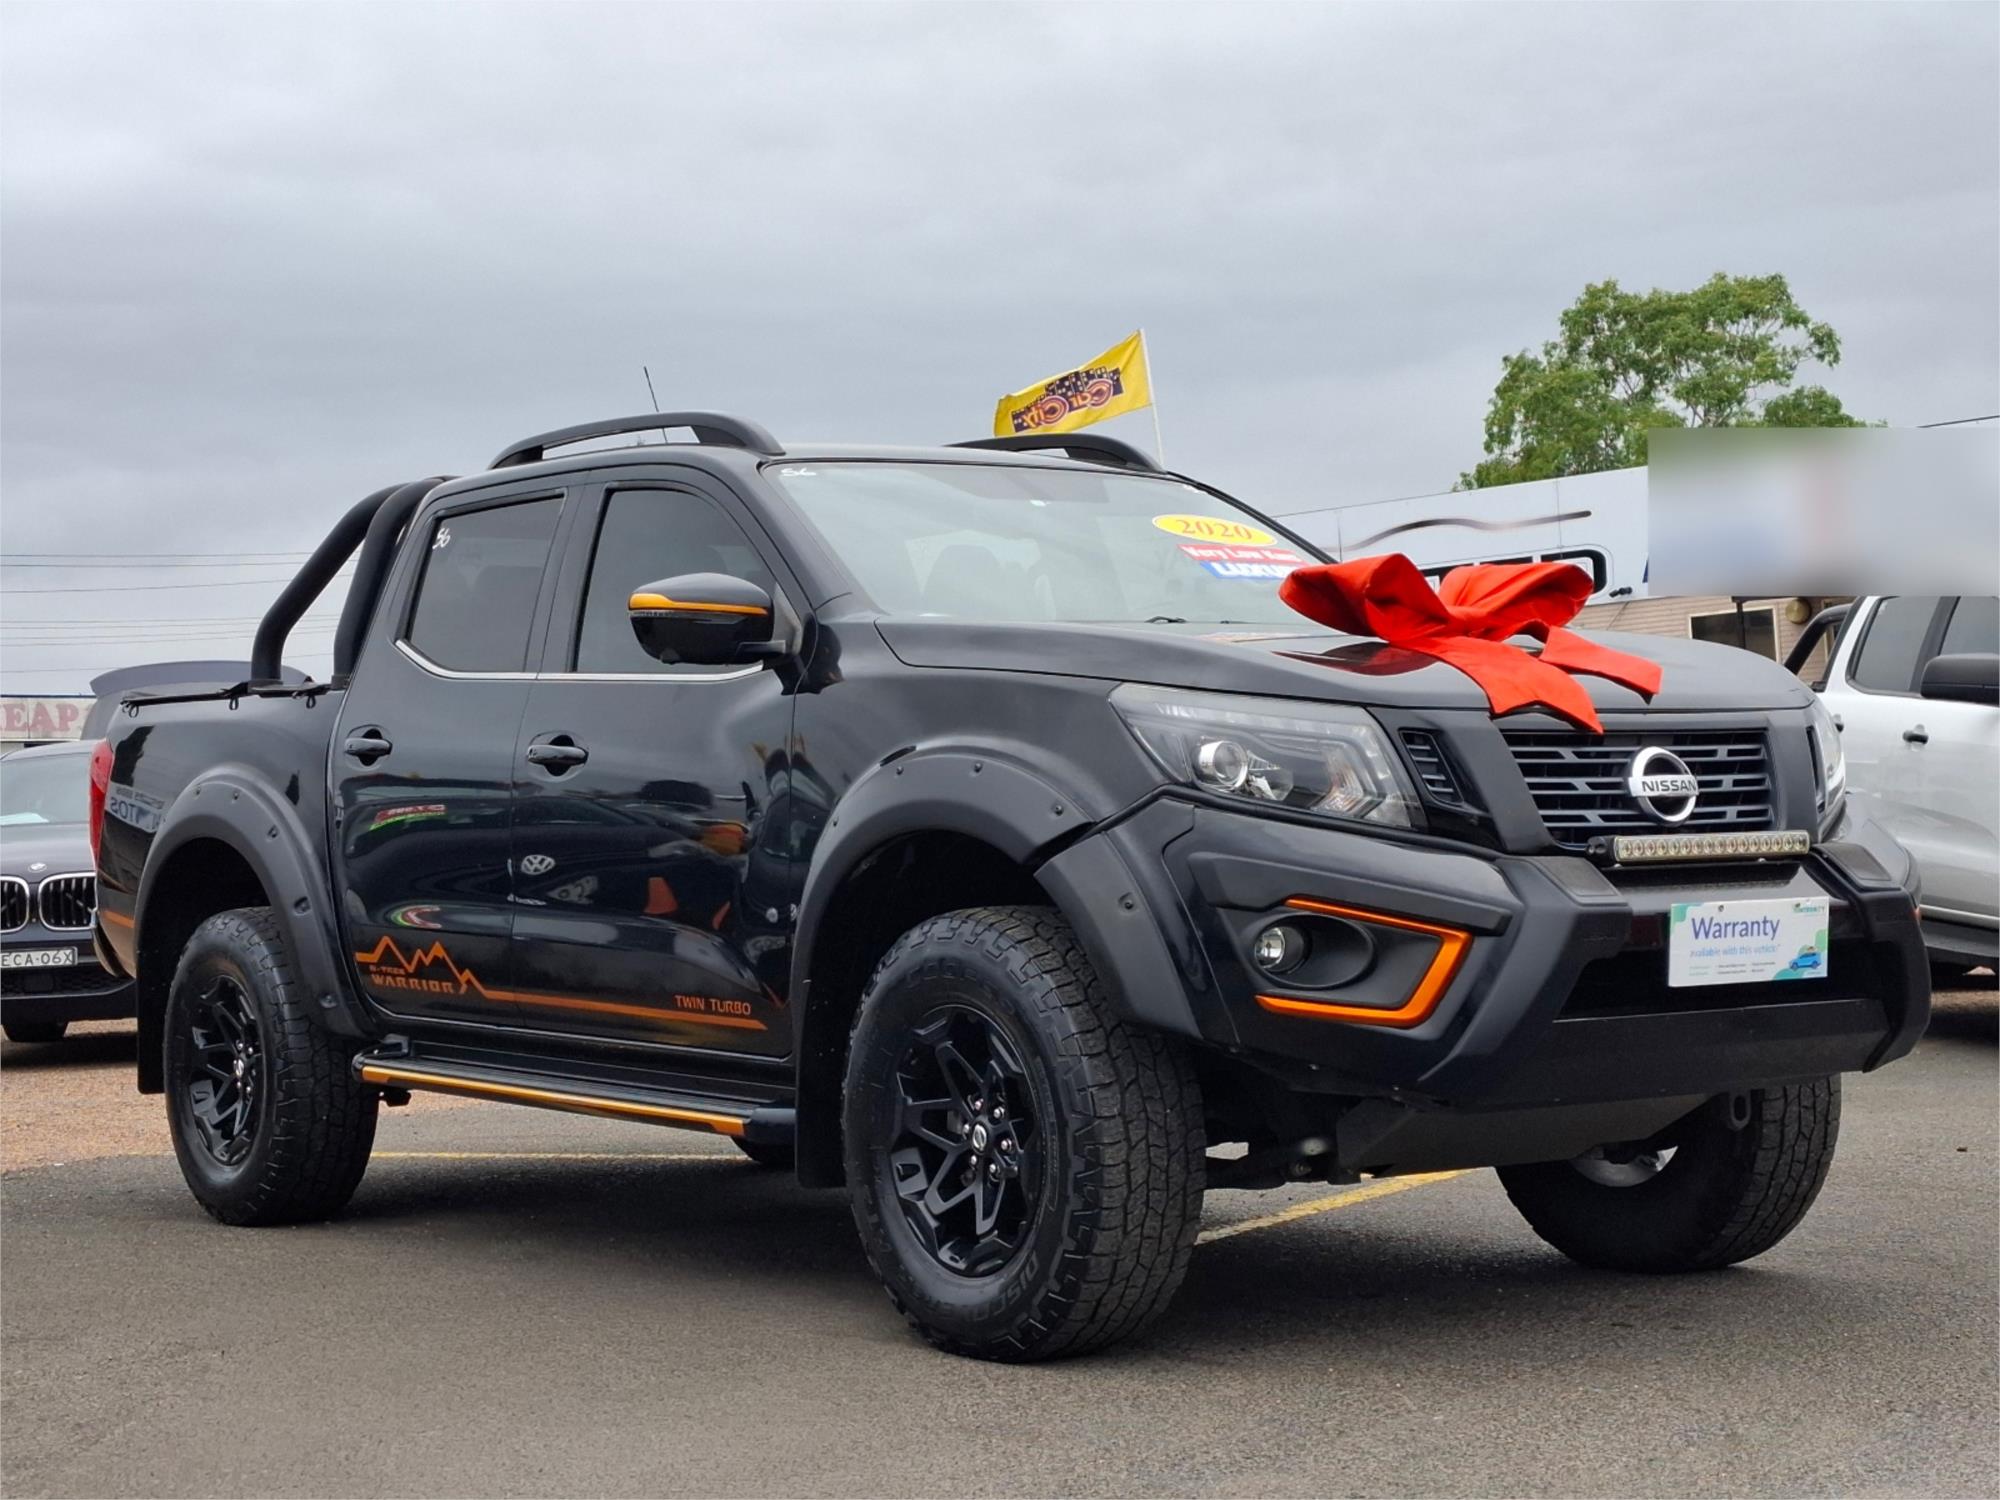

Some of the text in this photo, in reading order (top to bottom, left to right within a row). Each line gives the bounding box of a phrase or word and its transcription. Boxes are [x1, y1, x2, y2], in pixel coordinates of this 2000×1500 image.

[1175, 518, 1253, 541] 2020
[0, 702, 80, 732] EAP
[1641, 780, 1697, 792] NISSAN
[1691, 915, 1781, 940] Warranty
[371, 973, 454, 994] WARRIOR
[674, 994, 751, 1015] TWIN TURBO
